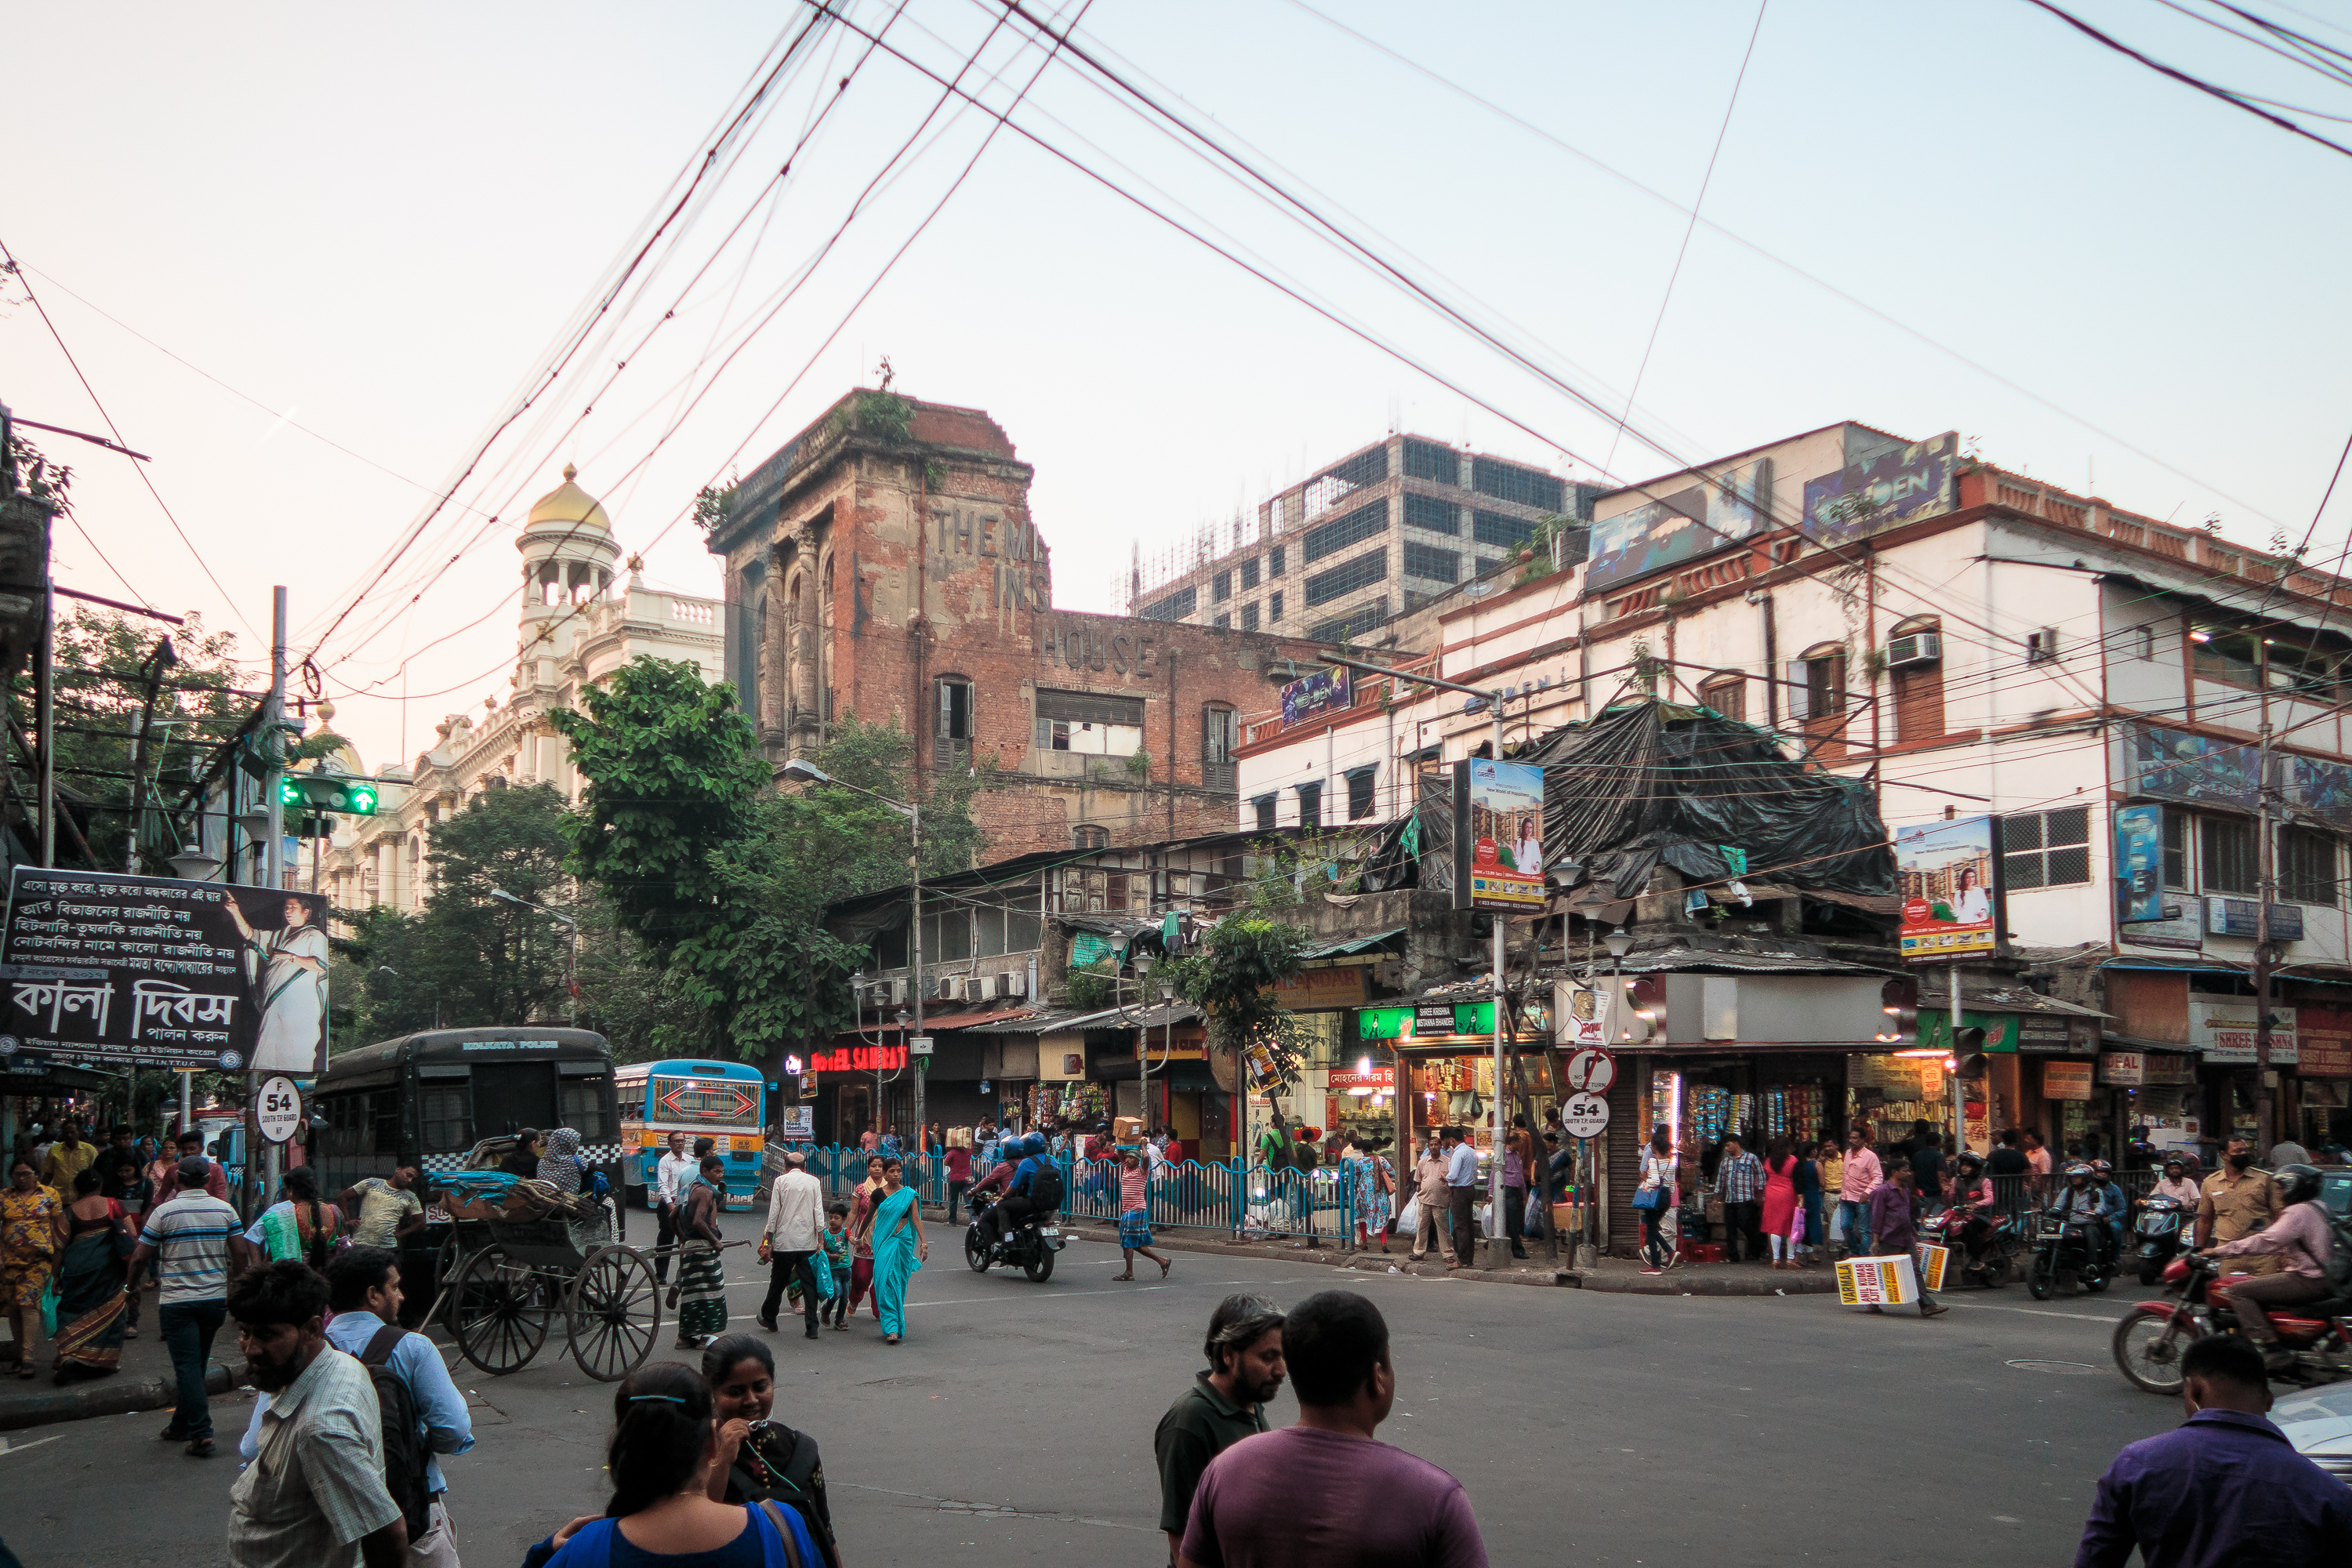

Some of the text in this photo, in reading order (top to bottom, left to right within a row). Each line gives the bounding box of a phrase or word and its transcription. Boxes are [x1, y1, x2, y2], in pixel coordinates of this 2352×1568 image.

[994, 564, 1050, 612] INS
[1041, 627, 1153, 677] HOUSE
[22, 880, 46, 891] এসো
[49, 882, 68, 895] মুক্ত
[99, 884, 118, 898] মুক্ত
[119, 885, 142, 896] করো
[144, 887, 188, 899] অন্ধকারের
[191, 888, 205, 902] এই
[206, 891, 221, 902] দ্বার
[19, 901, 191, 922] আর বিভাজনের রাজনীতি নয়
[129, 924, 183, 938] রাজনীতি
[185, 930, 202, 940] নয়
[14, 935, 235, 959] নোটবন্দির নামে কালো রাজনীতি নয়
[129, 957, 151, 971] মমতা
[12, 979, 239, 1039] কালা দিবস
[1419, 1007, 1450, 1017] SHREE KRISHNA
[1436, 1017, 1454, 1026] BHANDER
[147, 1027, 229, 1043] পালন করুন
[2220, 1032, 2252, 1048] SHREE
[463, 1041, 515, 1050] KOLKATA
[276, 1082, 282, 1091] F
[1330, 1073, 1362, 1083] মোহনের
[267, 1094, 292, 1112] 54
[1573, 1104, 1599, 1116] 54
[1838, 1265, 1857, 1302] VARMALA
[1856, 1264, 1871, 1301] ANIL KUMAR
[1865, 1263, 1880, 1301] AJIT KUMAR
